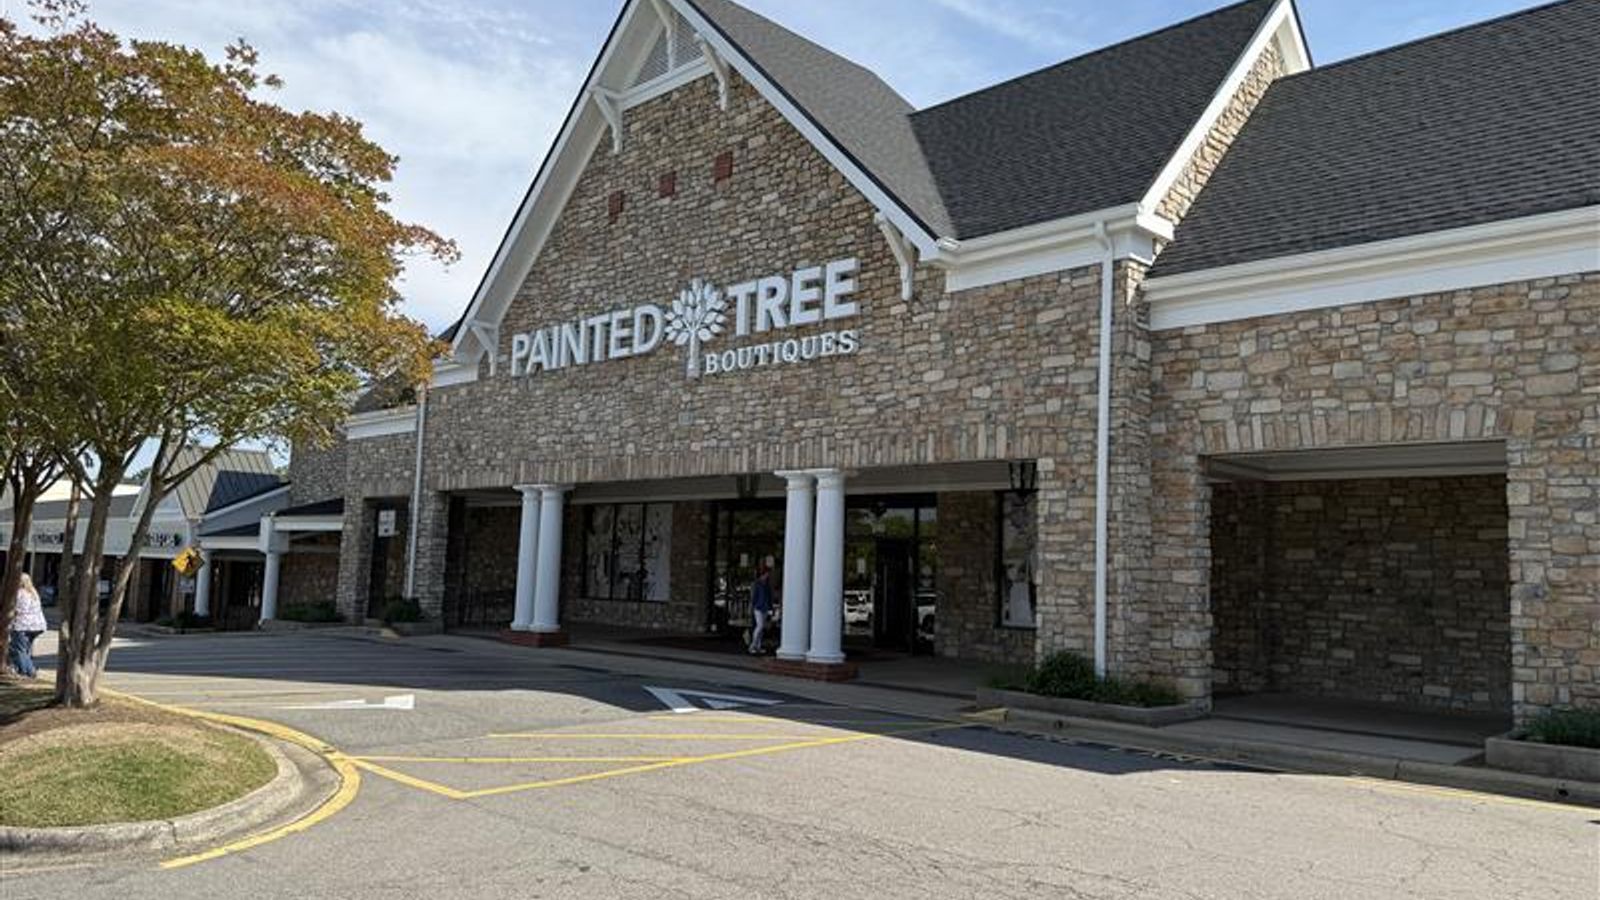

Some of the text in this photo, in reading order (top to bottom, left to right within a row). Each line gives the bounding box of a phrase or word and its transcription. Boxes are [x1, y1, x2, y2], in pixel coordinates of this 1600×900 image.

[511, 257, 860, 377] PAINTED TREE
[704, 329, 860, 375] BOUTIQUES
